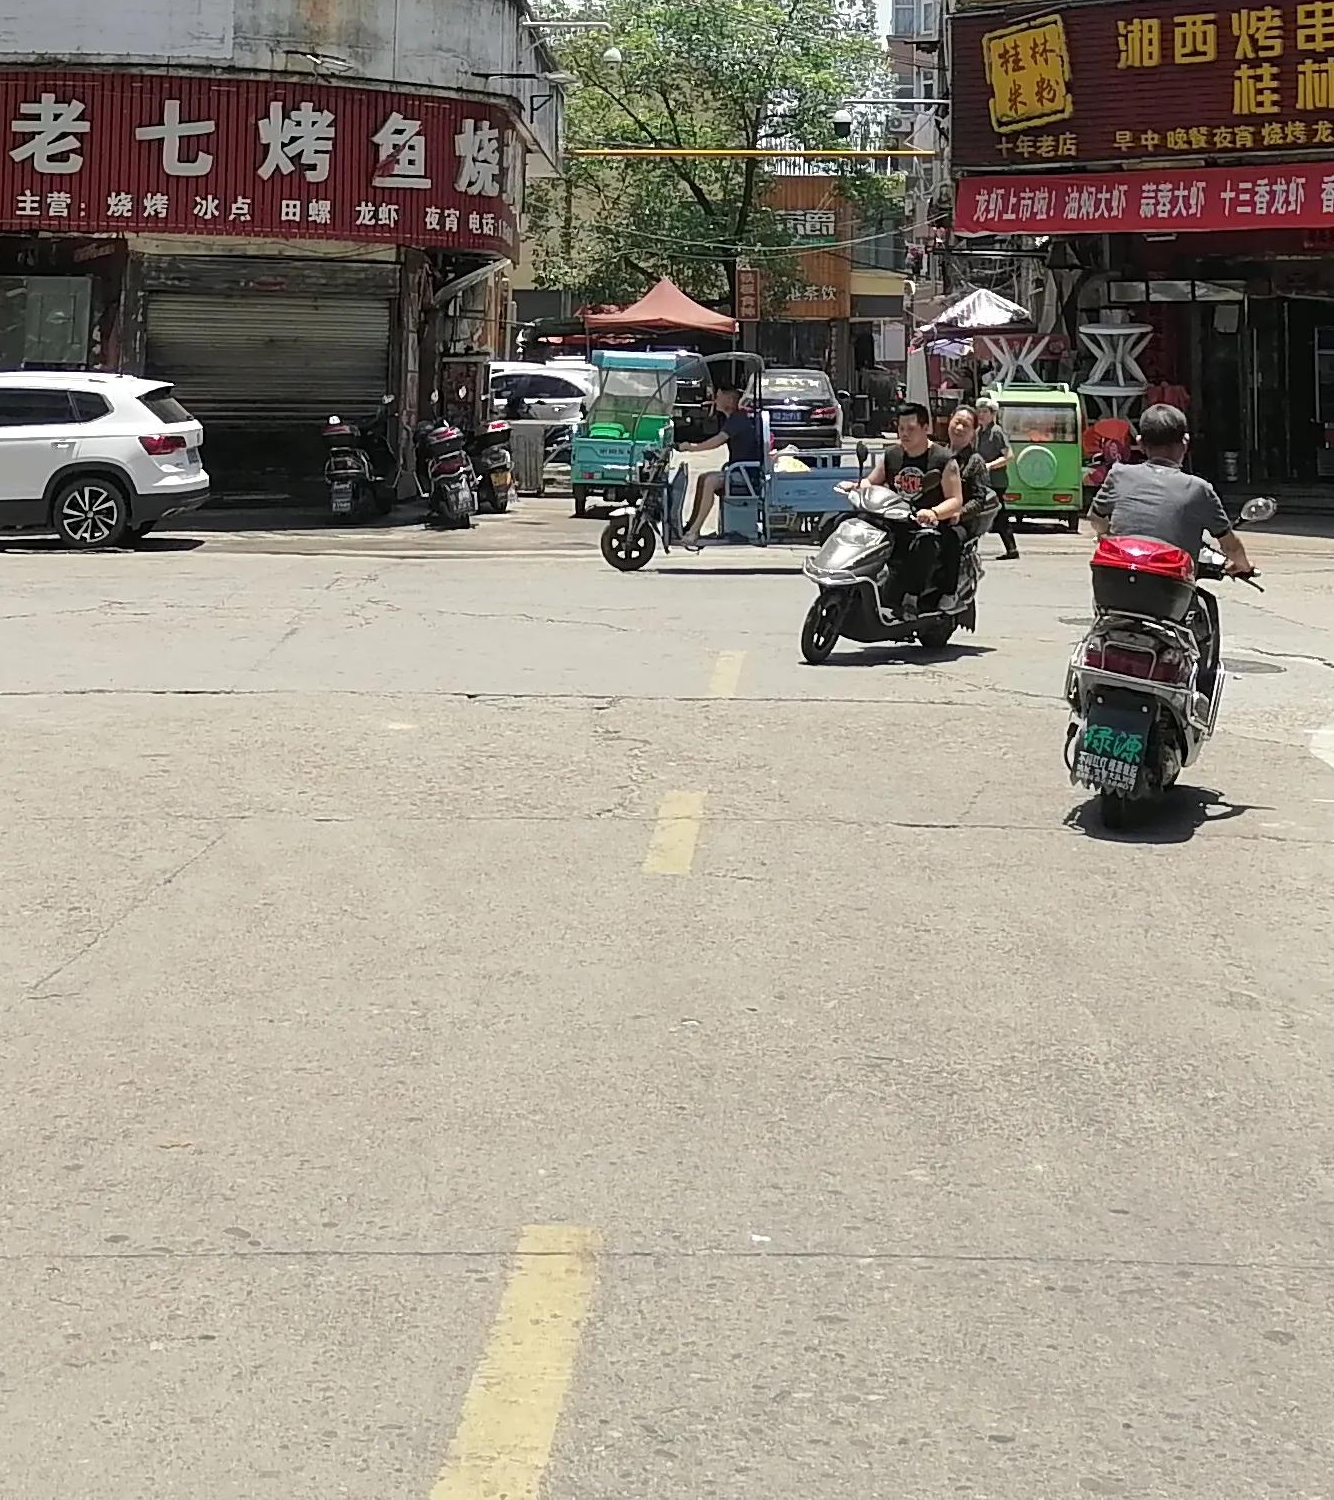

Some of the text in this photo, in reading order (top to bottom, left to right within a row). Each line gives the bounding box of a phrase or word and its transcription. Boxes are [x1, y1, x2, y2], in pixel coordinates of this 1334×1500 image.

[997, 32, 1057, 77] 桂林
[1007, 73, 1060, 115] 米粉
[995, 132, 1079, 159] 十年老店
[106, 191, 169, 219] 烧烤
[193, 194, 252, 222] 冰点
[281, 195, 332, 225] 田螺
[354, 201, 399, 228] 龙虾
[425, 206, 460, 233] 夜宵
[1063, 182, 1129, 222] 油焖大虾
[1139, 180, 1207, 219] 蒜蓉大虾
[1220, 176, 1306, 217] 十三香龙虾
